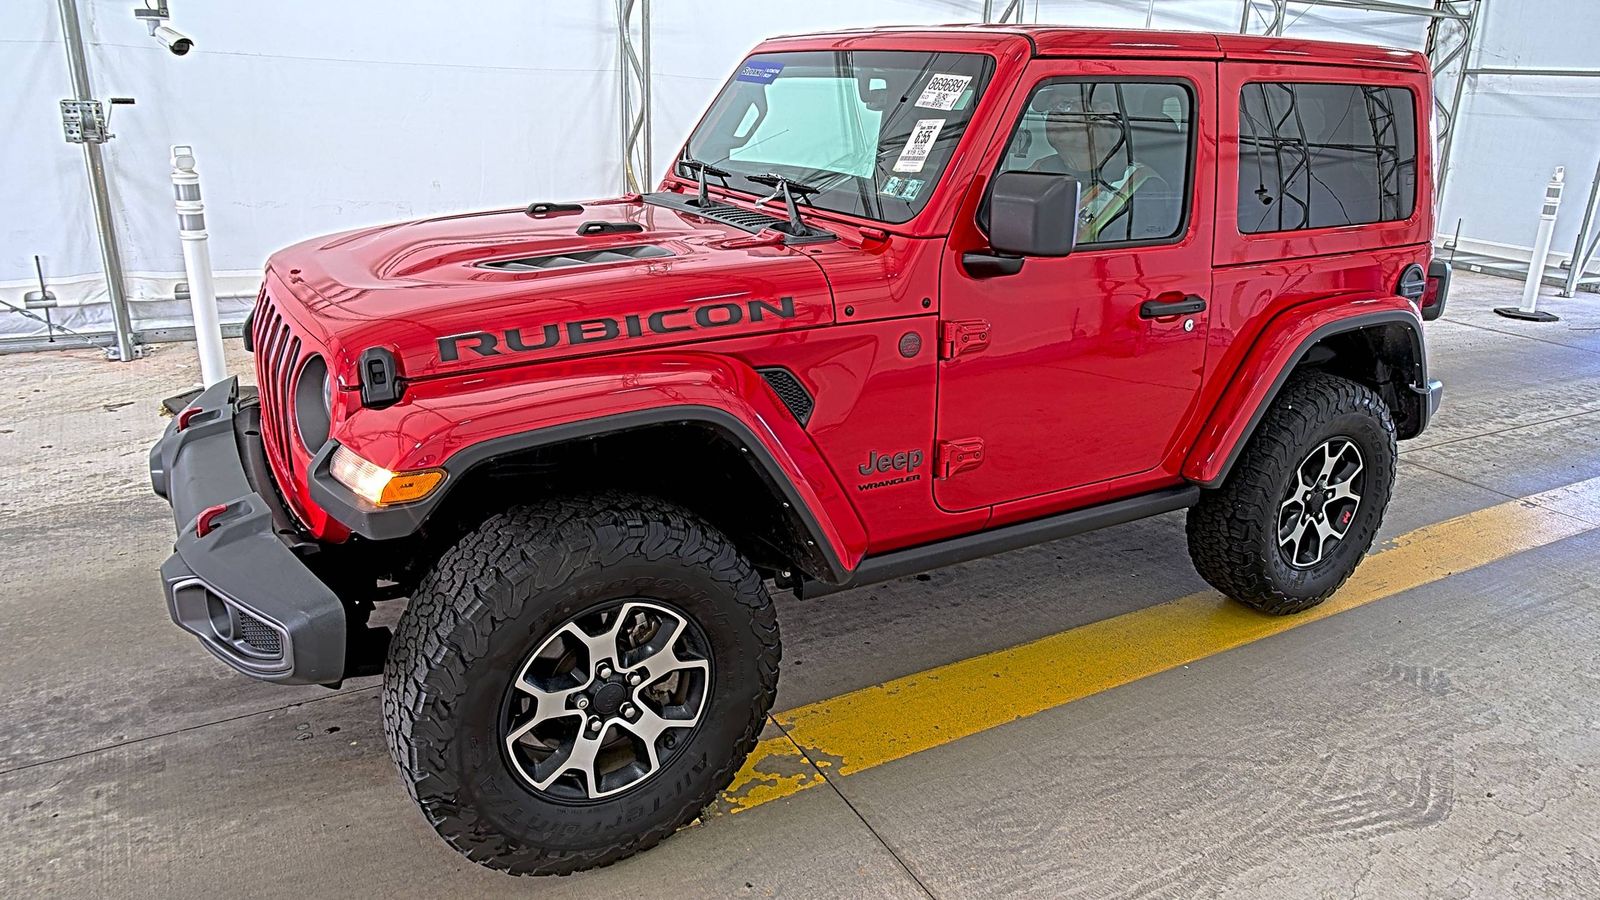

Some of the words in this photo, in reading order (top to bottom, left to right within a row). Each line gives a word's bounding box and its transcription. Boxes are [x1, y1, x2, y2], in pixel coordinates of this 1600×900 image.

[928, 77, 969, 93] 8696891
[437, 296, 796, 363] RUBICON
[858, 449, 923, 475] Jeep
[858, 474, 921, 491] WRANGLER
